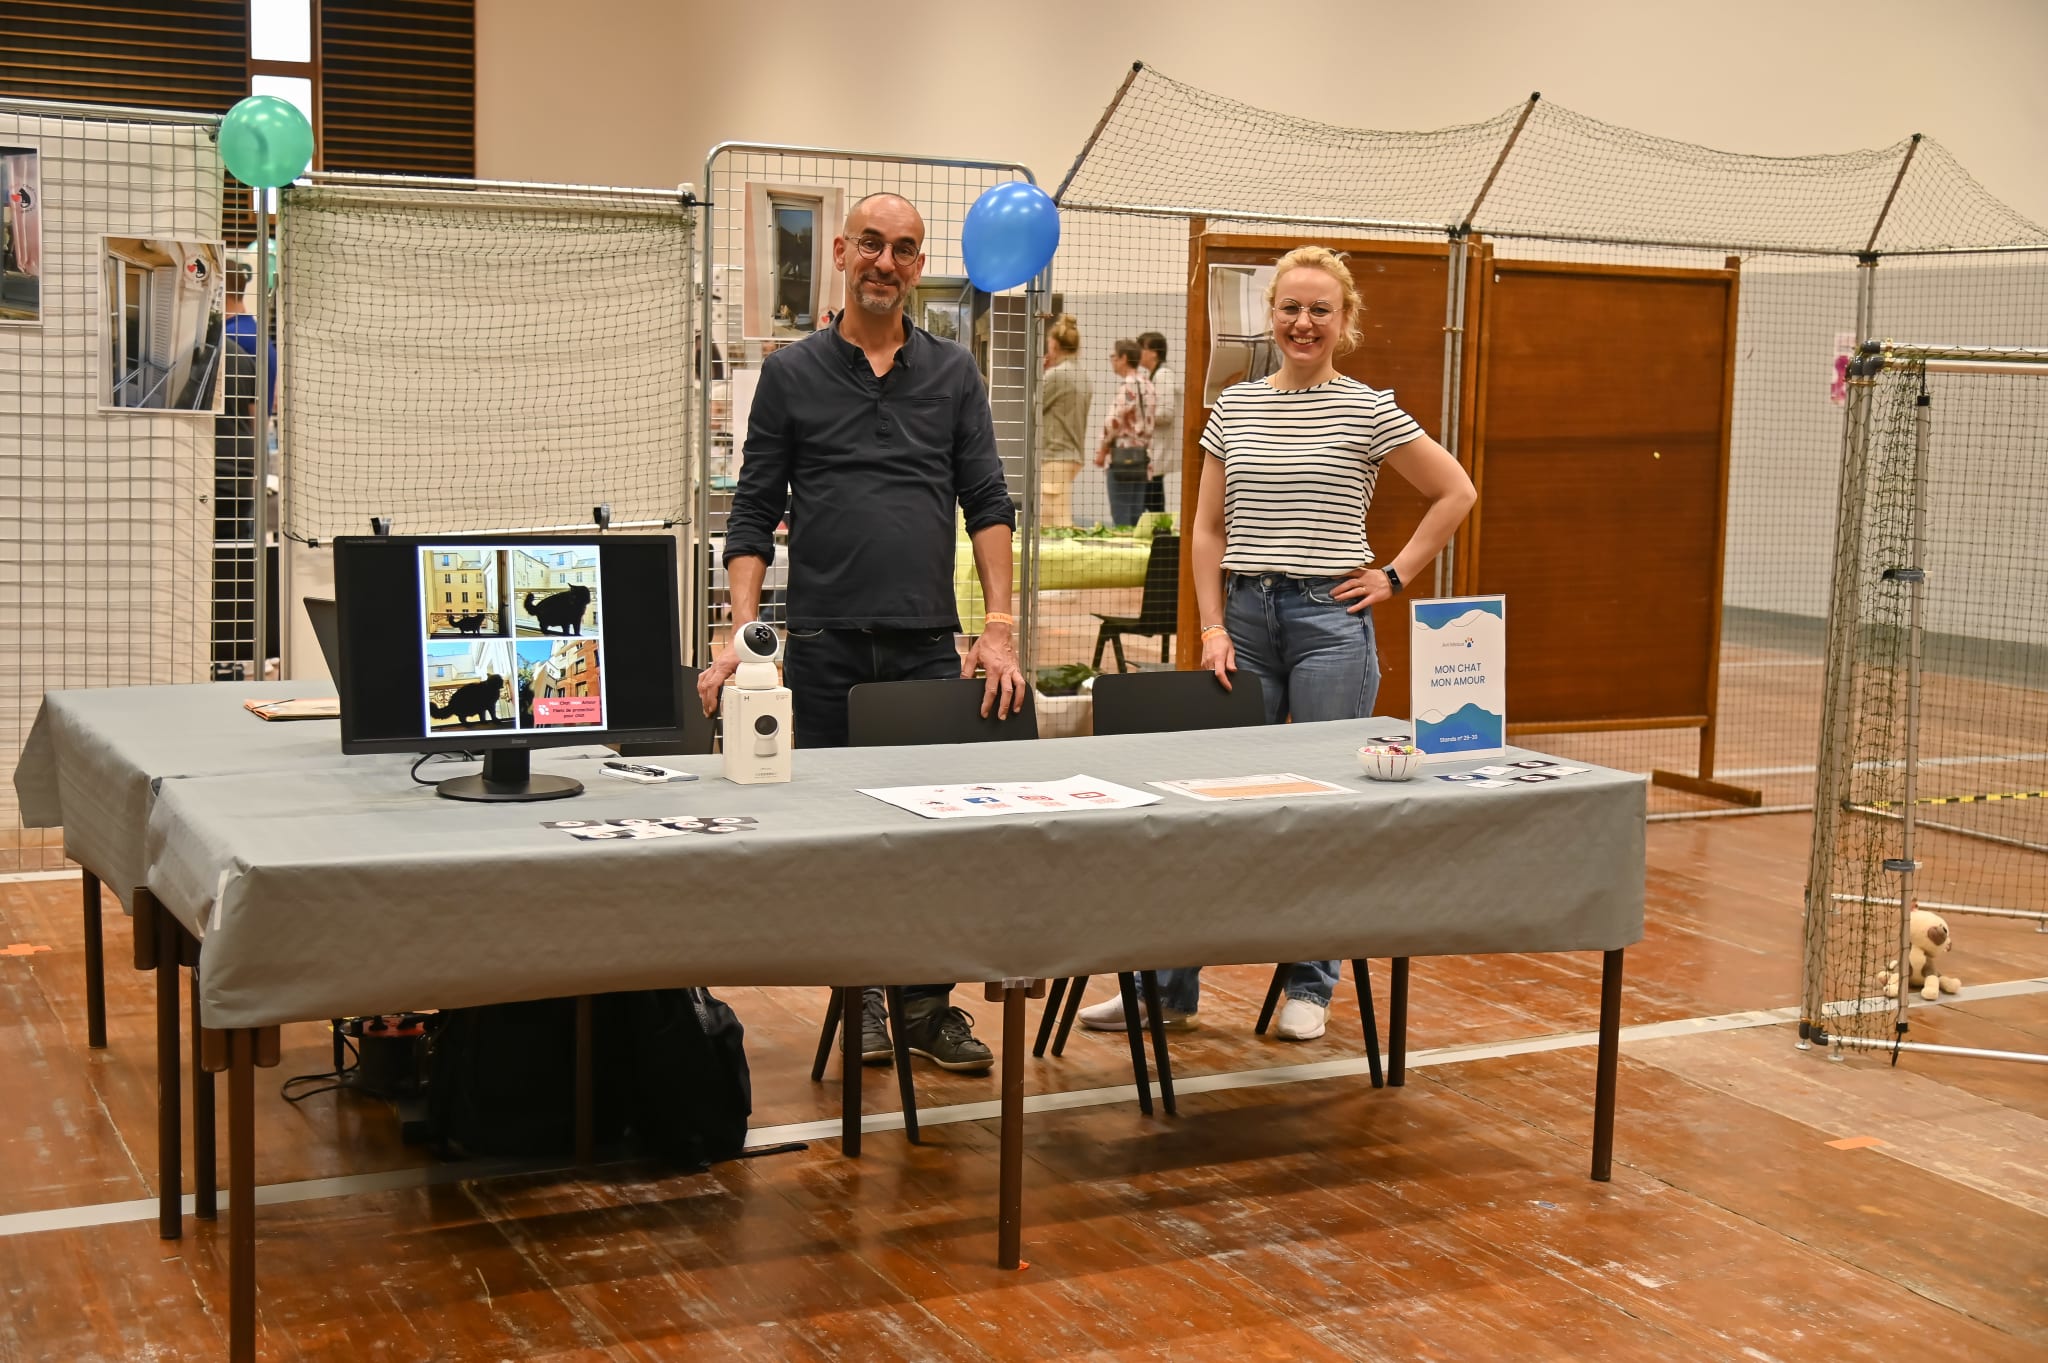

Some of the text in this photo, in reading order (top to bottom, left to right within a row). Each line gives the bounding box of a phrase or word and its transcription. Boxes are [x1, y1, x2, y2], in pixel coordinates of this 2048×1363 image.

[1434, 662, 1482, 674] MON CHAT
[1431, 675, 1486, 687] MON AMOUR
